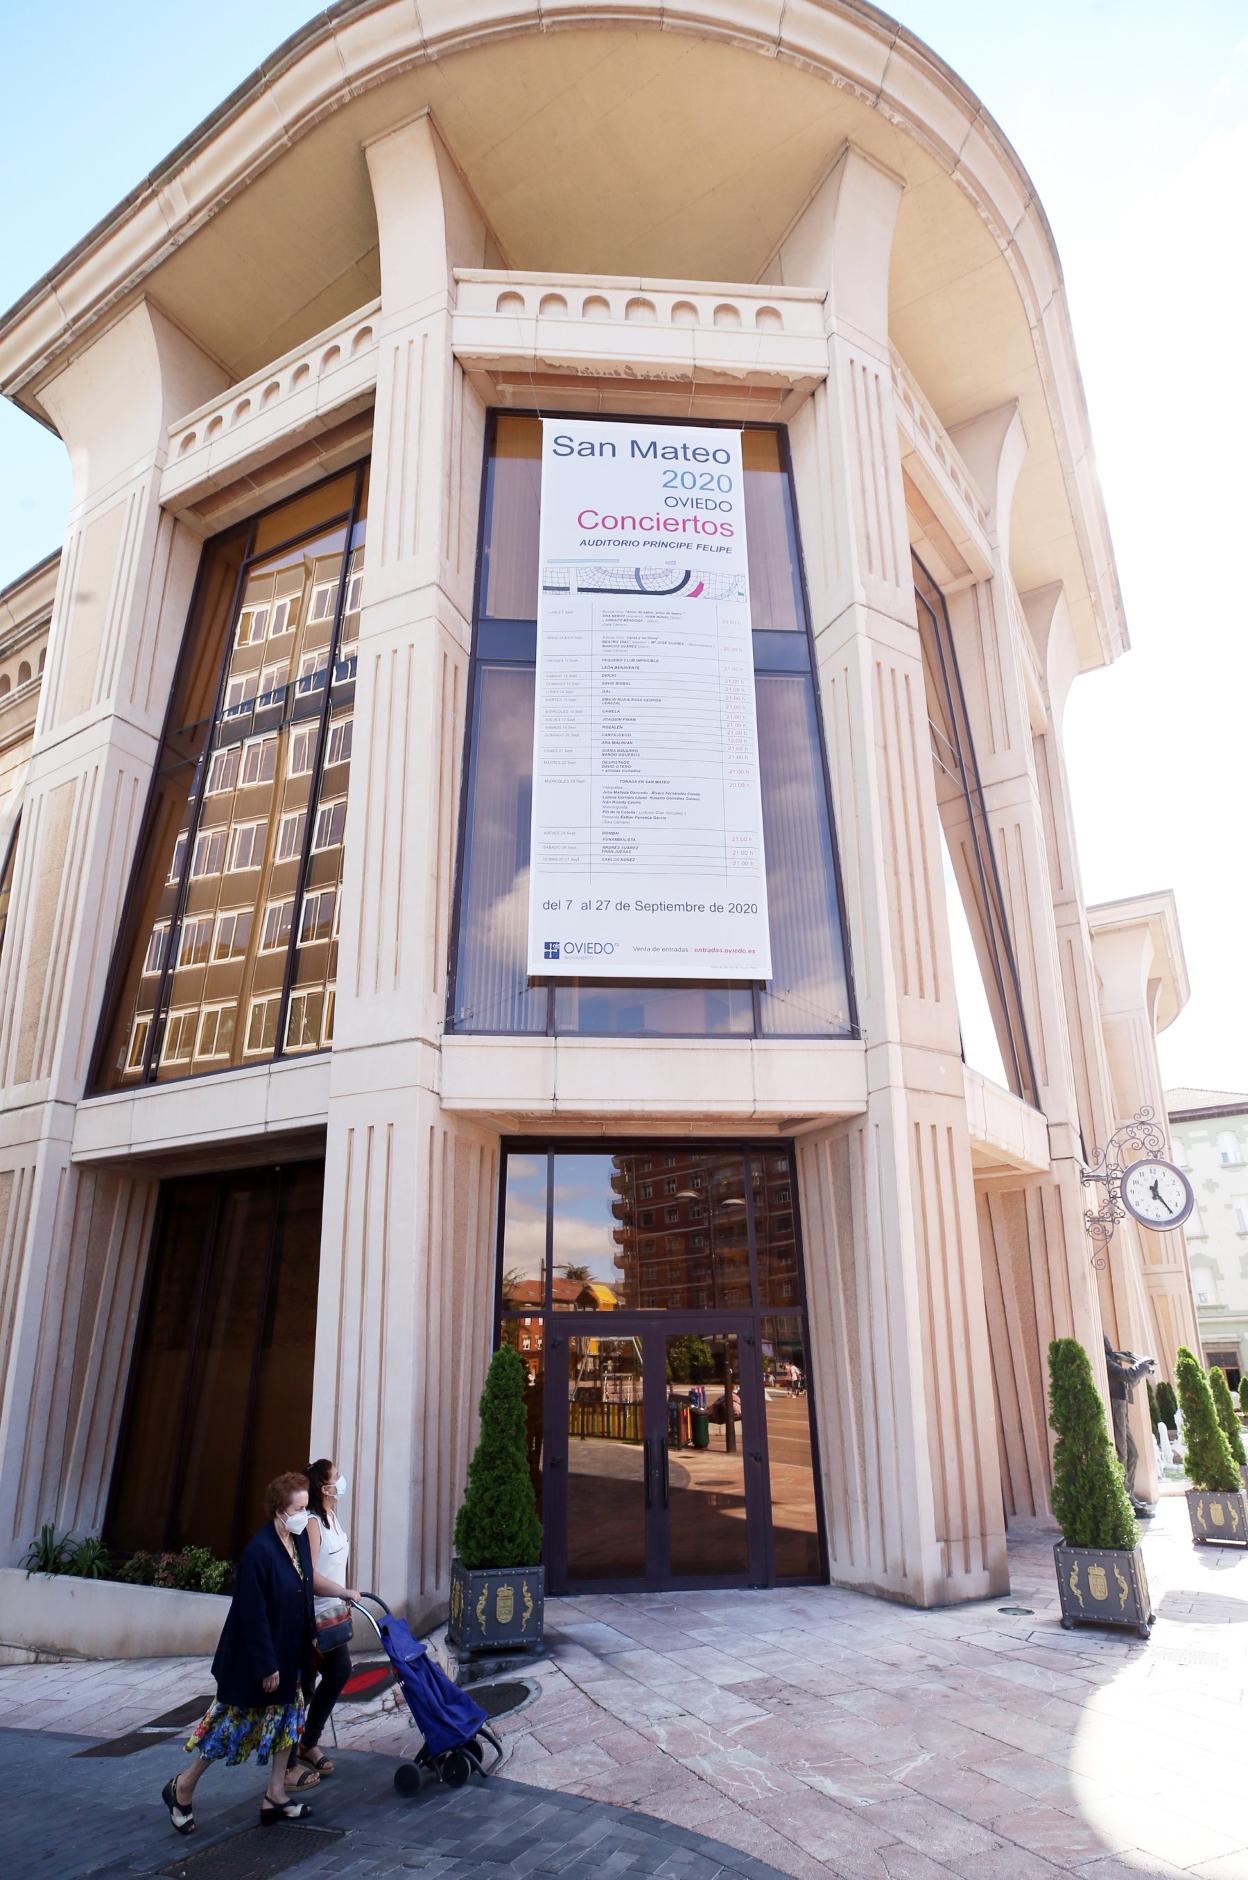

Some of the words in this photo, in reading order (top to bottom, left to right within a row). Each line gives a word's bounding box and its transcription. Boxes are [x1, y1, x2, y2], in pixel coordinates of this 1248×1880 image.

[552, 435, 616, 458] San
[631, 440, 731, 465] Mateo
[662, 470, 733, 493] 2020
[664, 496, 733, 513] OVIEDO
[577, 509, 735, 538] Conciertos
[579, 538, 640, 548] AUDITORIO
[643, 539, 693, 550] PRÍNCIPE
[696, 543, 733, 554] FELIPE
[543, 899, 561, 911] del
[565, 899, 573, 911] 7
[580, 899, 591, 911] al
[595, 900, 611, 911] 27
[615, 900, 631, 912] de
[634, 900, 705, 914] Septiembre
[709, 902, 724, 913] de
[728, 902, 758, 914] 2020
[564, 941, 615, 955] OVIEDO
